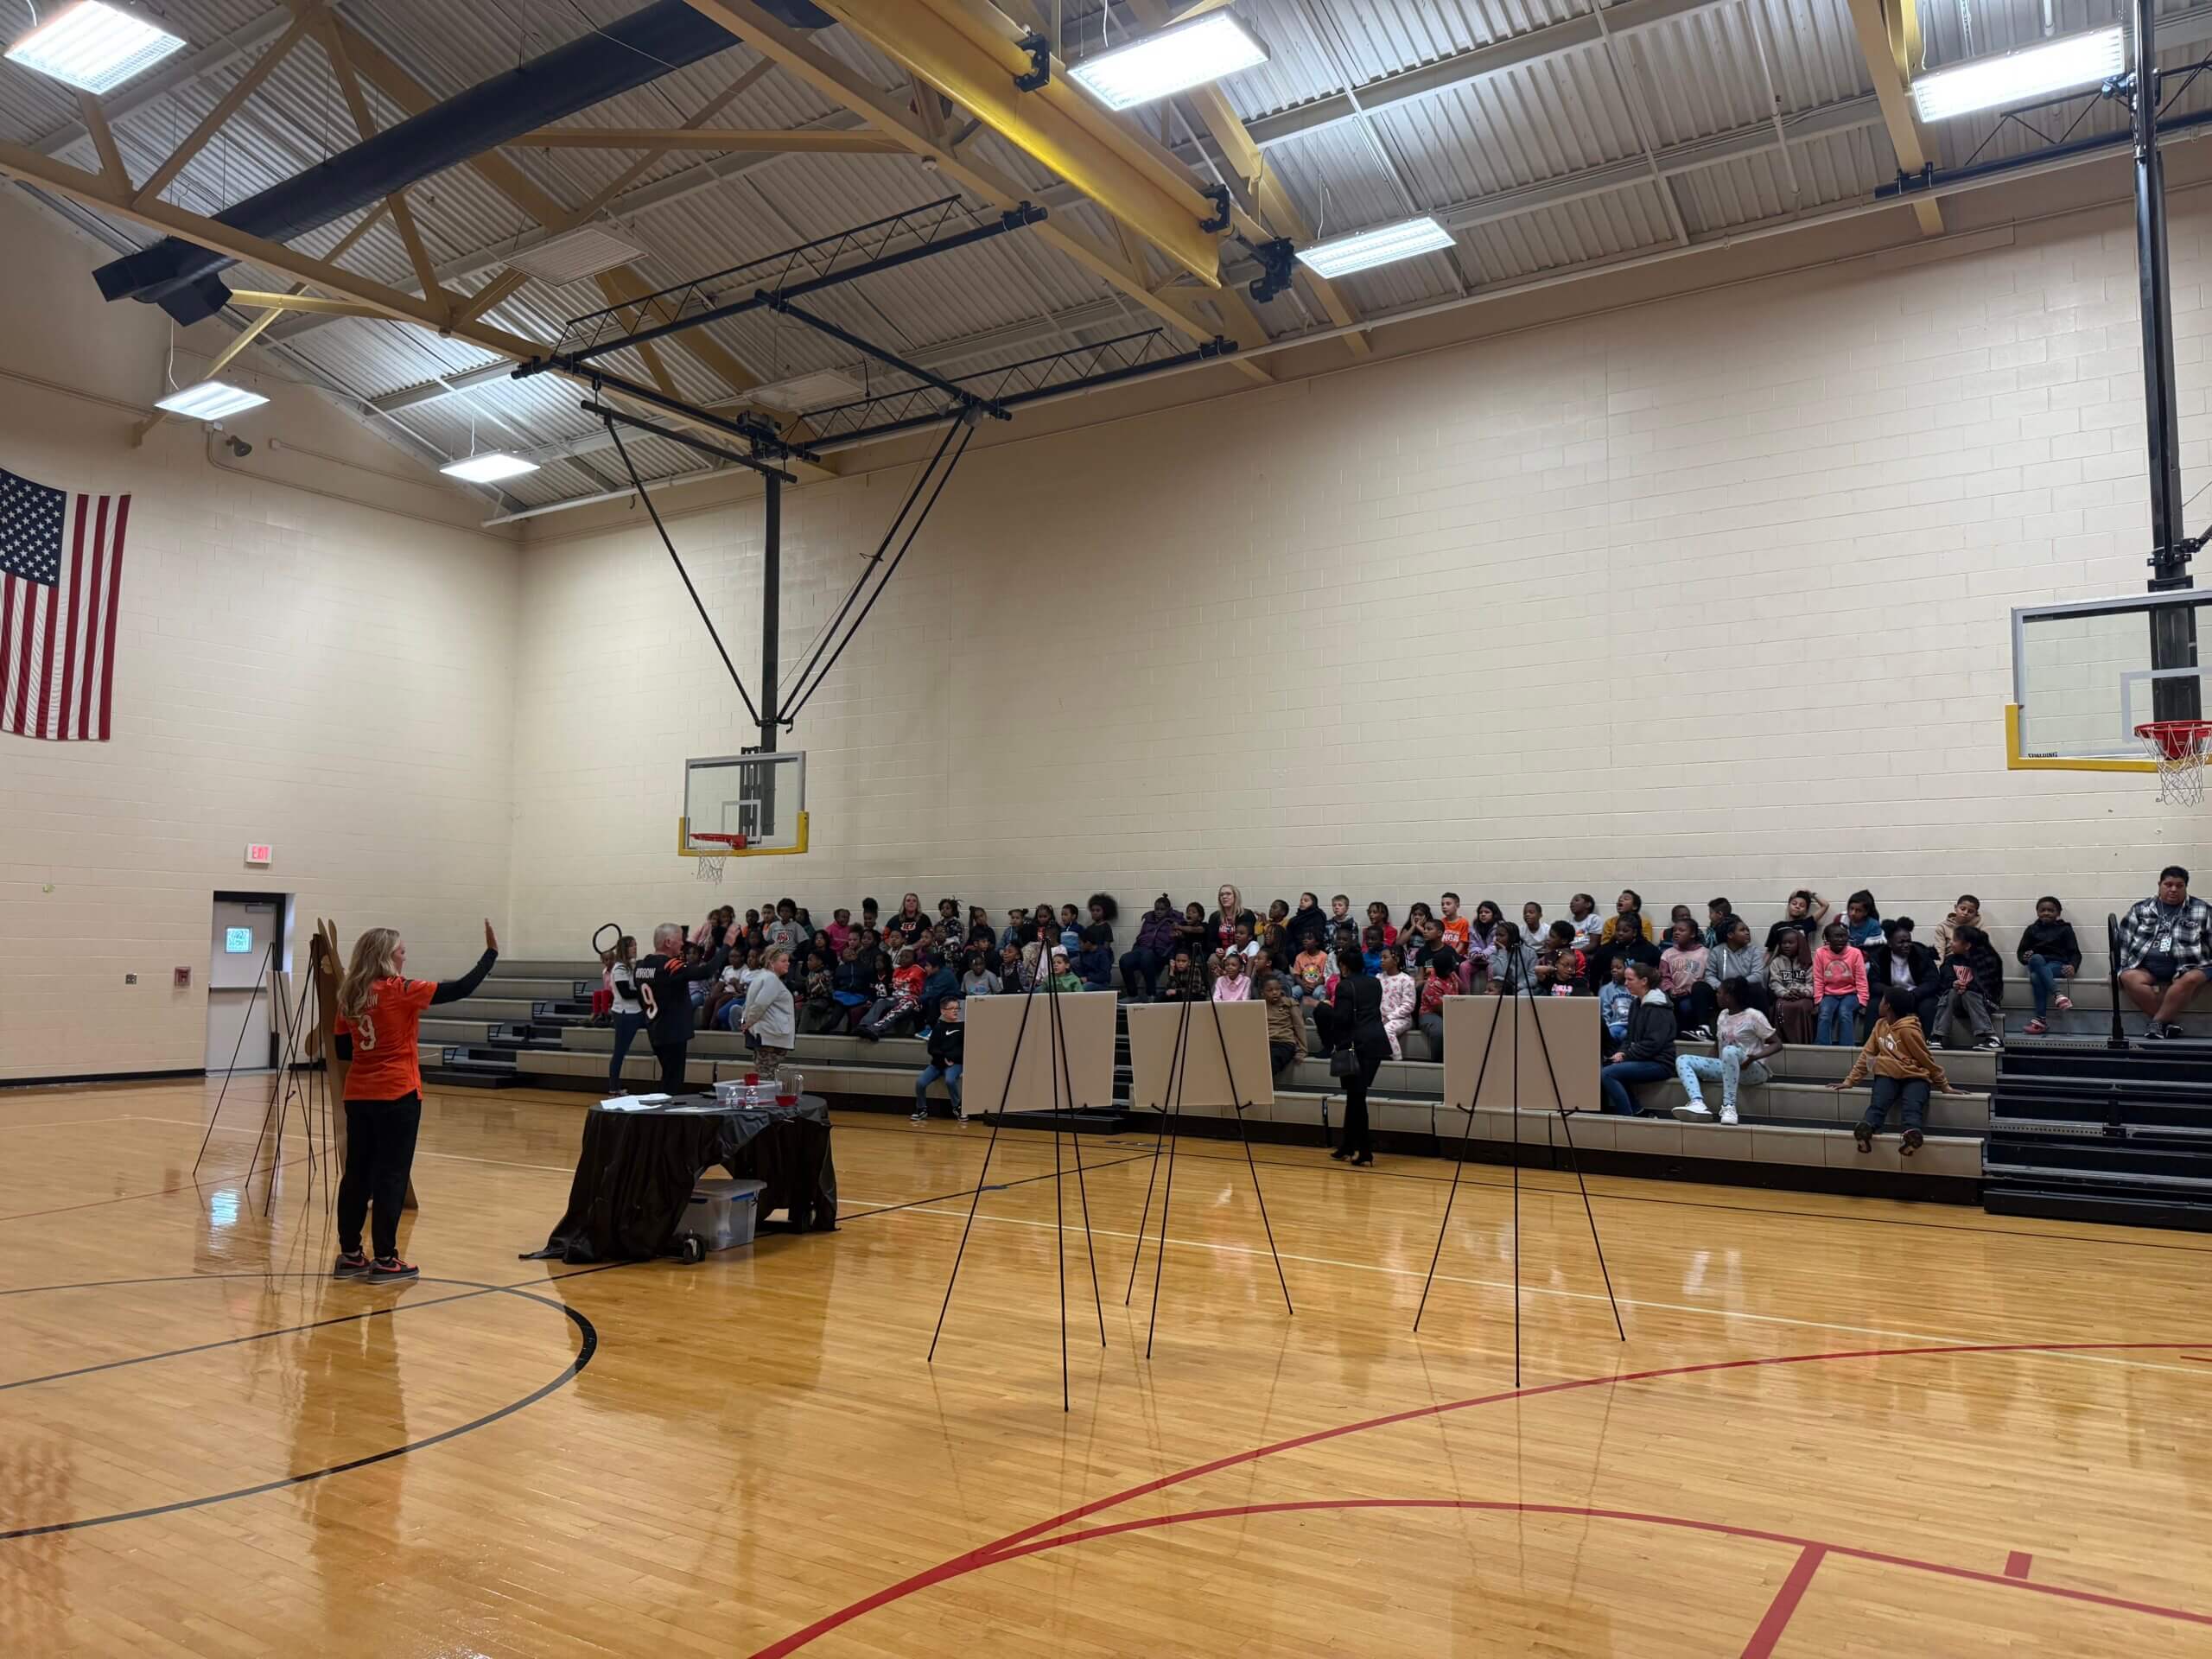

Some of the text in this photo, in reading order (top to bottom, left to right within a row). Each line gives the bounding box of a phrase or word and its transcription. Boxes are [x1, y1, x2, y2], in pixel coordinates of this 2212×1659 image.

[252, 846, 269, 860] EXIT
[641, 982, 658, 1020] 9
[359, 1014, 377, 1051] 9
